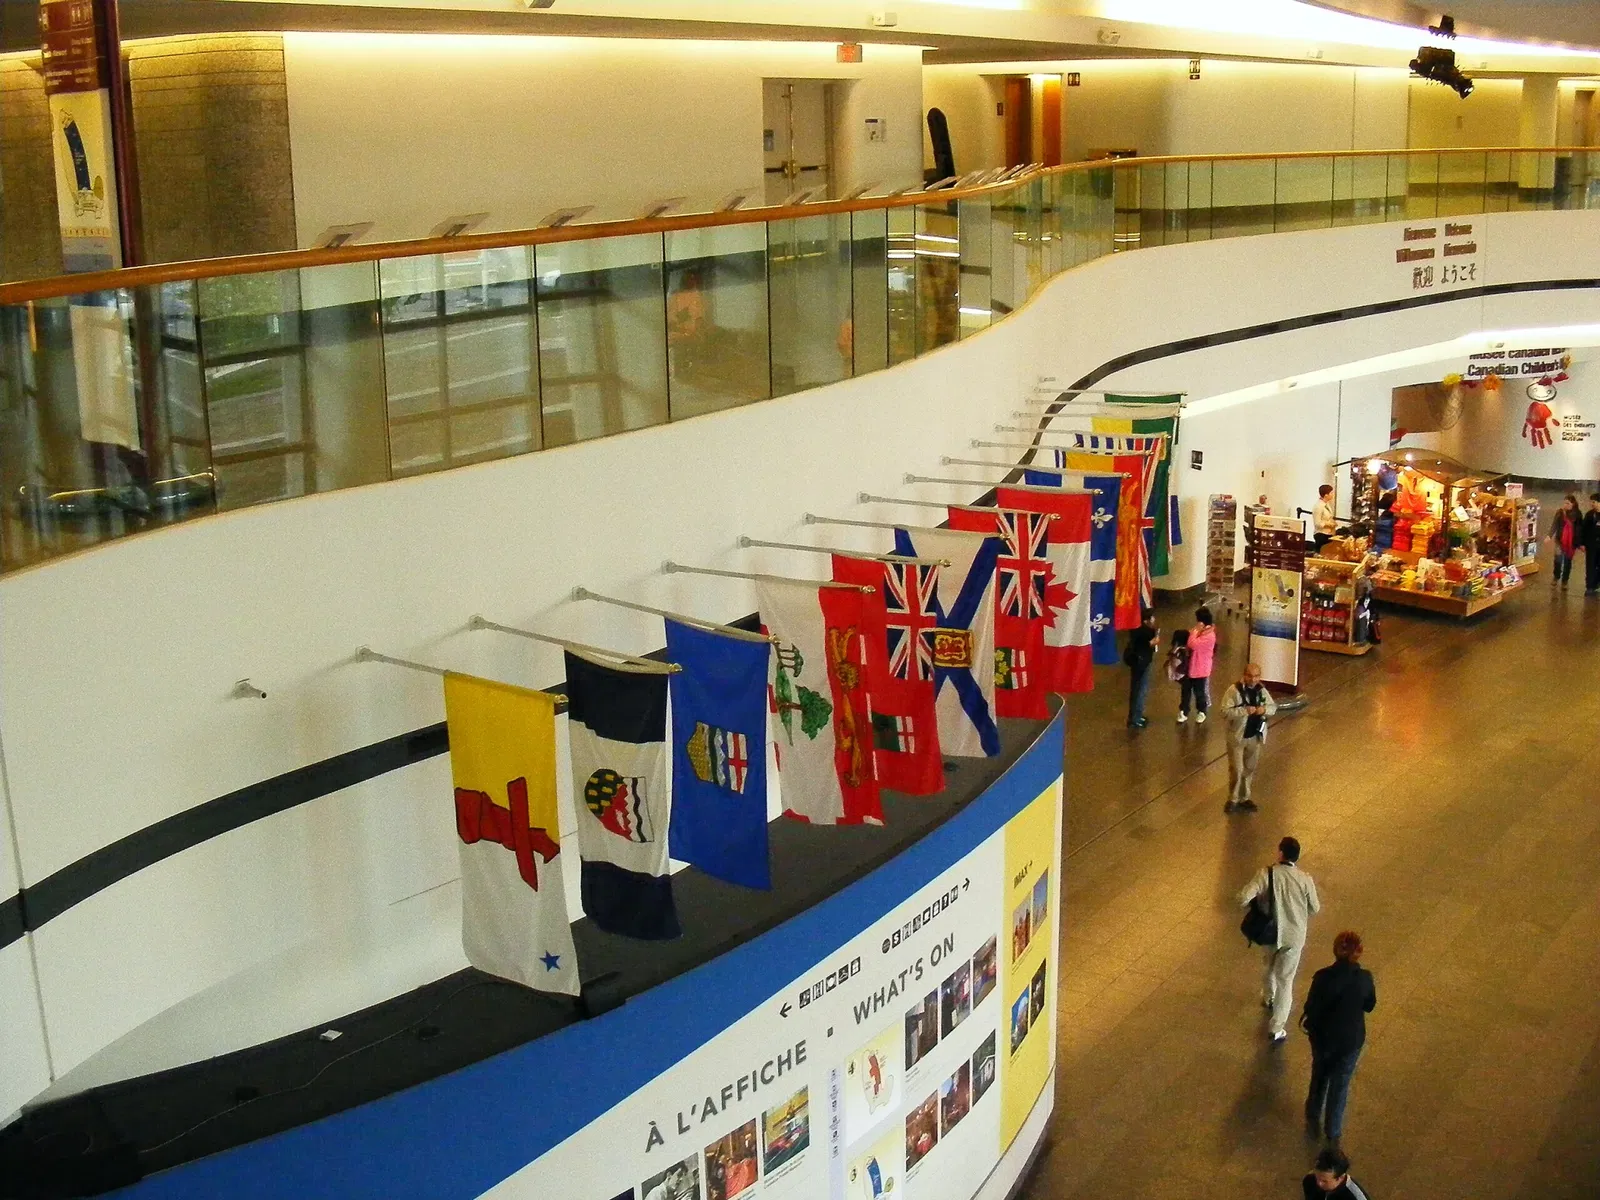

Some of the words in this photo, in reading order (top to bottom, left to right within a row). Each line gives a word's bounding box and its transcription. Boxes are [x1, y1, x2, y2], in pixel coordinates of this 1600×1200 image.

[1441, 263, 1477, 284] ようこそ
[1467, 363, 1518, 377] Canadian
[645, 1120, 665, 1153] À
[677, 1039, 807, 1135] L'AFFICHE
[853, 957, 924, 1025] WHAT'S
[930, 932, 954, 967] ON
